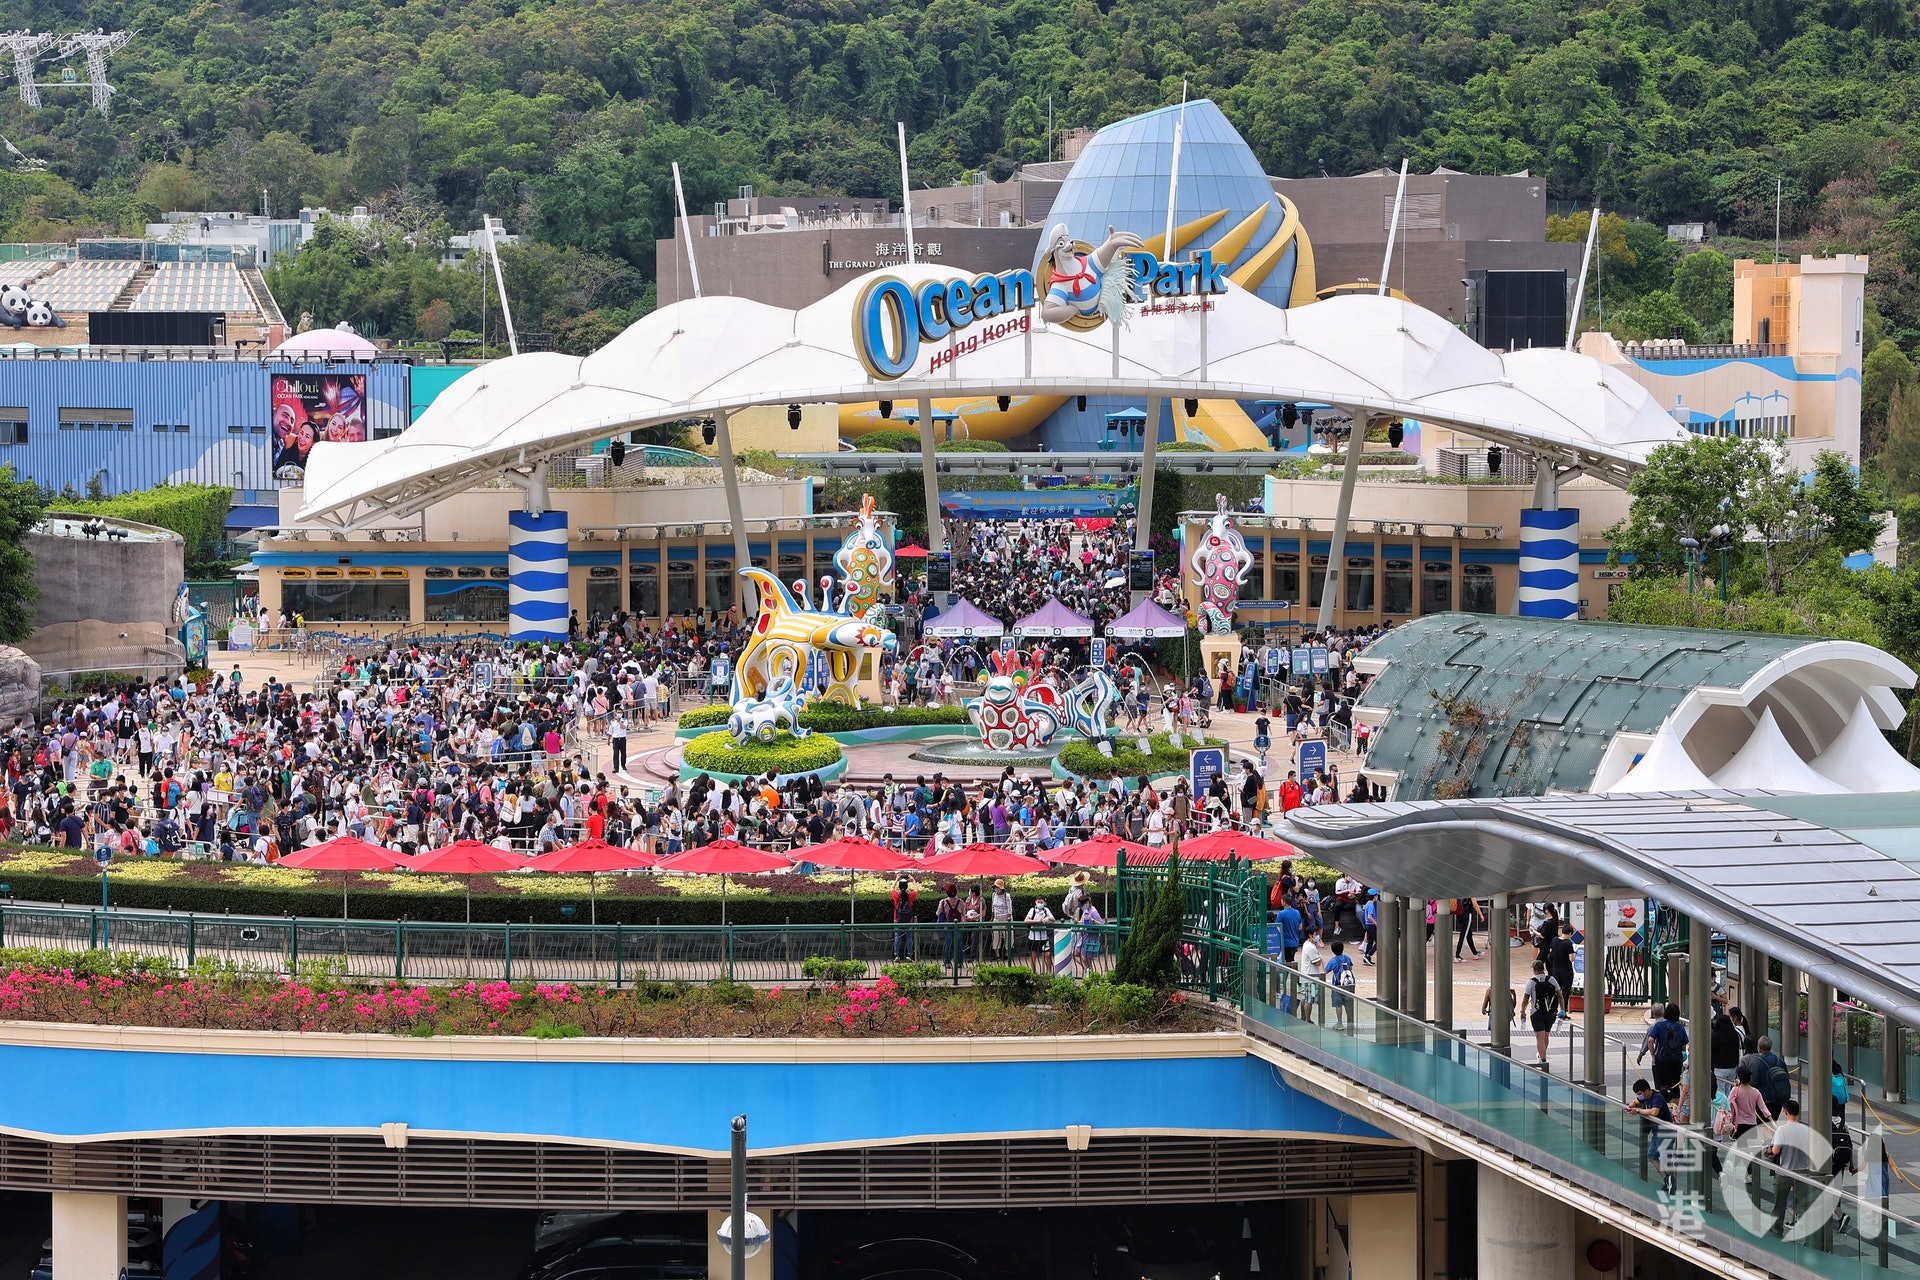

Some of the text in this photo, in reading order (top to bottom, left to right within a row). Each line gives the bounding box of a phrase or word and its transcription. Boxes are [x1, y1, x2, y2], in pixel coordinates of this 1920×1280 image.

[829, 260, 843, 269] THE
[845, 260, 876, 269] GRAND
[875, 242, 942, 256] 海洋奇觀
[852, 249, 1228, 381] Ocean Park
[930, 314, 1030, 374] Hong Kong
